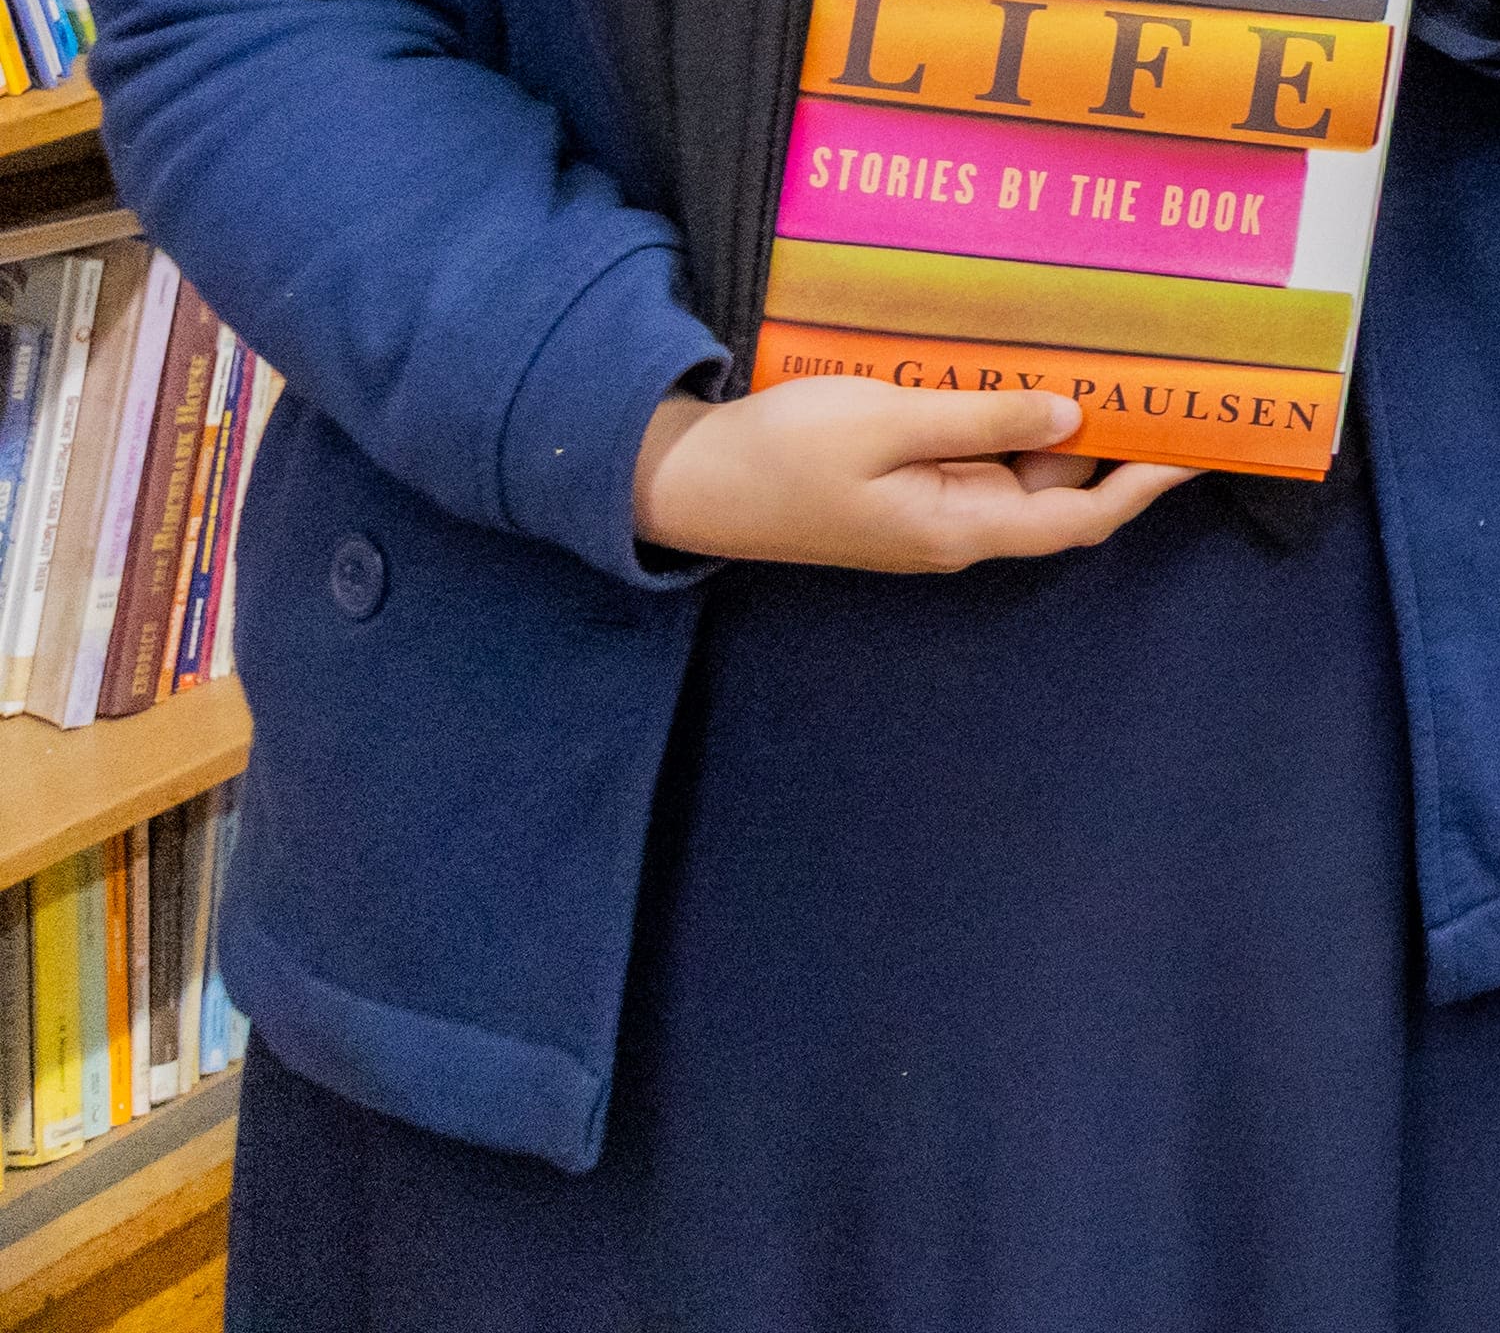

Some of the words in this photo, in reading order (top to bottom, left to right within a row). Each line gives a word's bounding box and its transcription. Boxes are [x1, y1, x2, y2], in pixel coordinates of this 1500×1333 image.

[808, 147, 977, 205] STORIES
[999, 167, 1049, 214] BY
[1071, 175, 1138, 224] THE
[1160, 185, 1266, 237] BOOK
[782, 355, 845, 378] EDITED
[853, 363, 875, 379] BY
[892, 359, 1046, 391] GARY
[1072, 378, 1320, 433] PAULSEN
